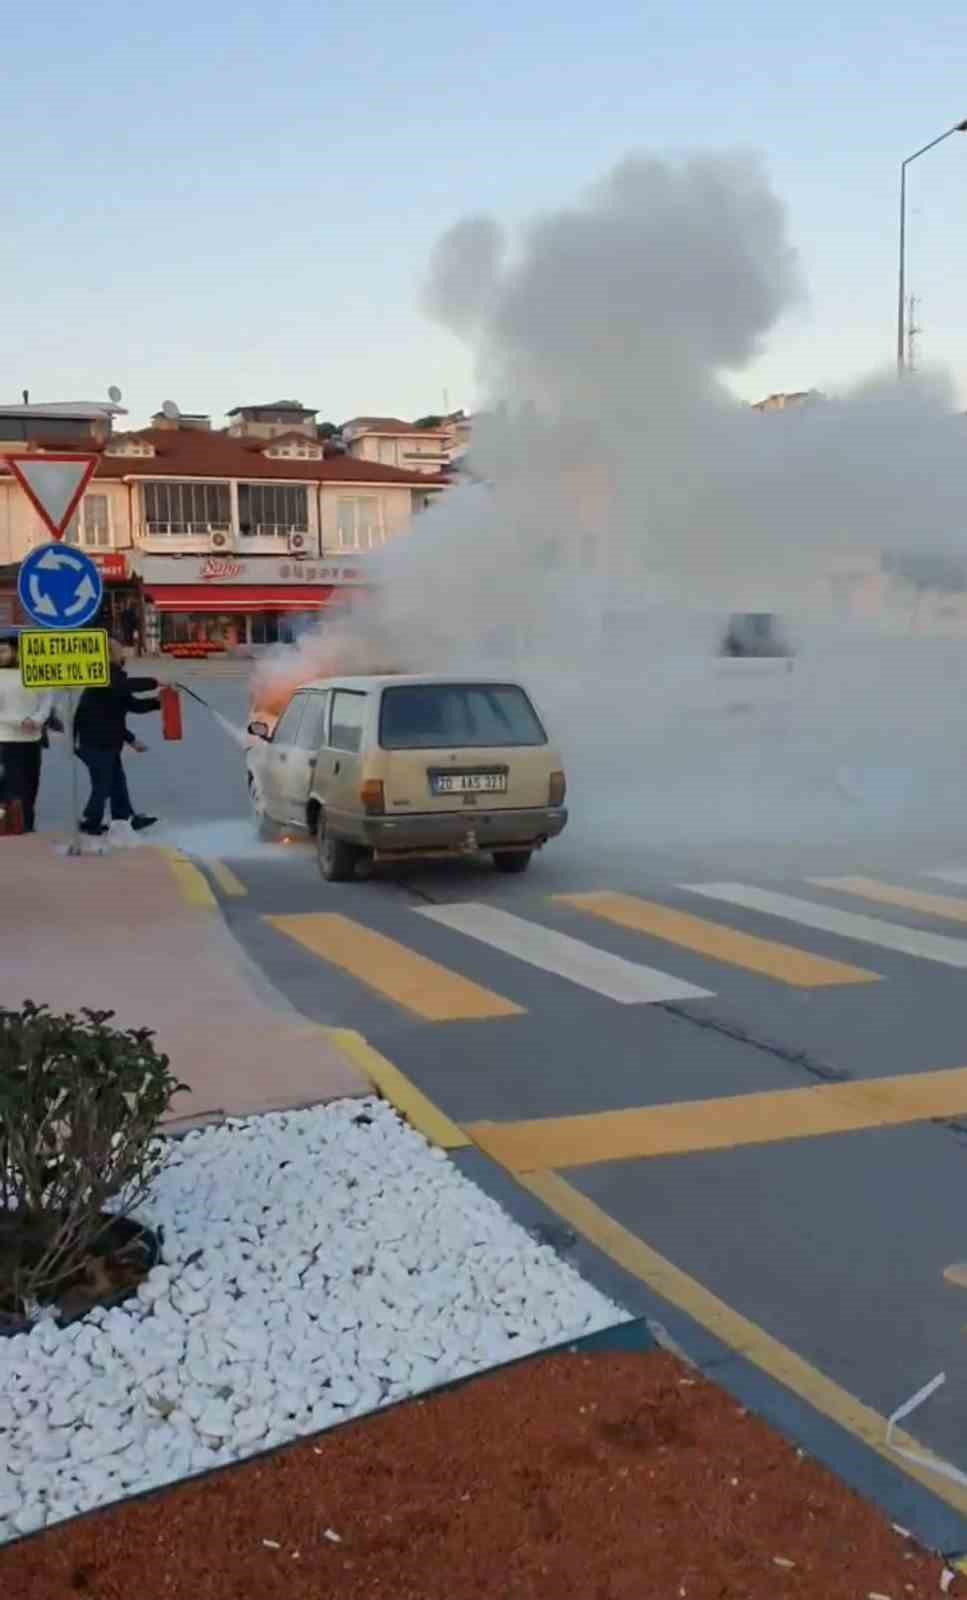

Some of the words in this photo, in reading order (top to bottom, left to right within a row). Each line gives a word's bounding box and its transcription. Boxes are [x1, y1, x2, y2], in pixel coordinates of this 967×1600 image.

[27, 637, 46, 656] ADA
[50, 636, 100, 656] ETRAFINDA
[25, 659, 64, 682] DÖNENE
[67, 662, 83, 681] YOL
[88, 661, 104, 680] VER
